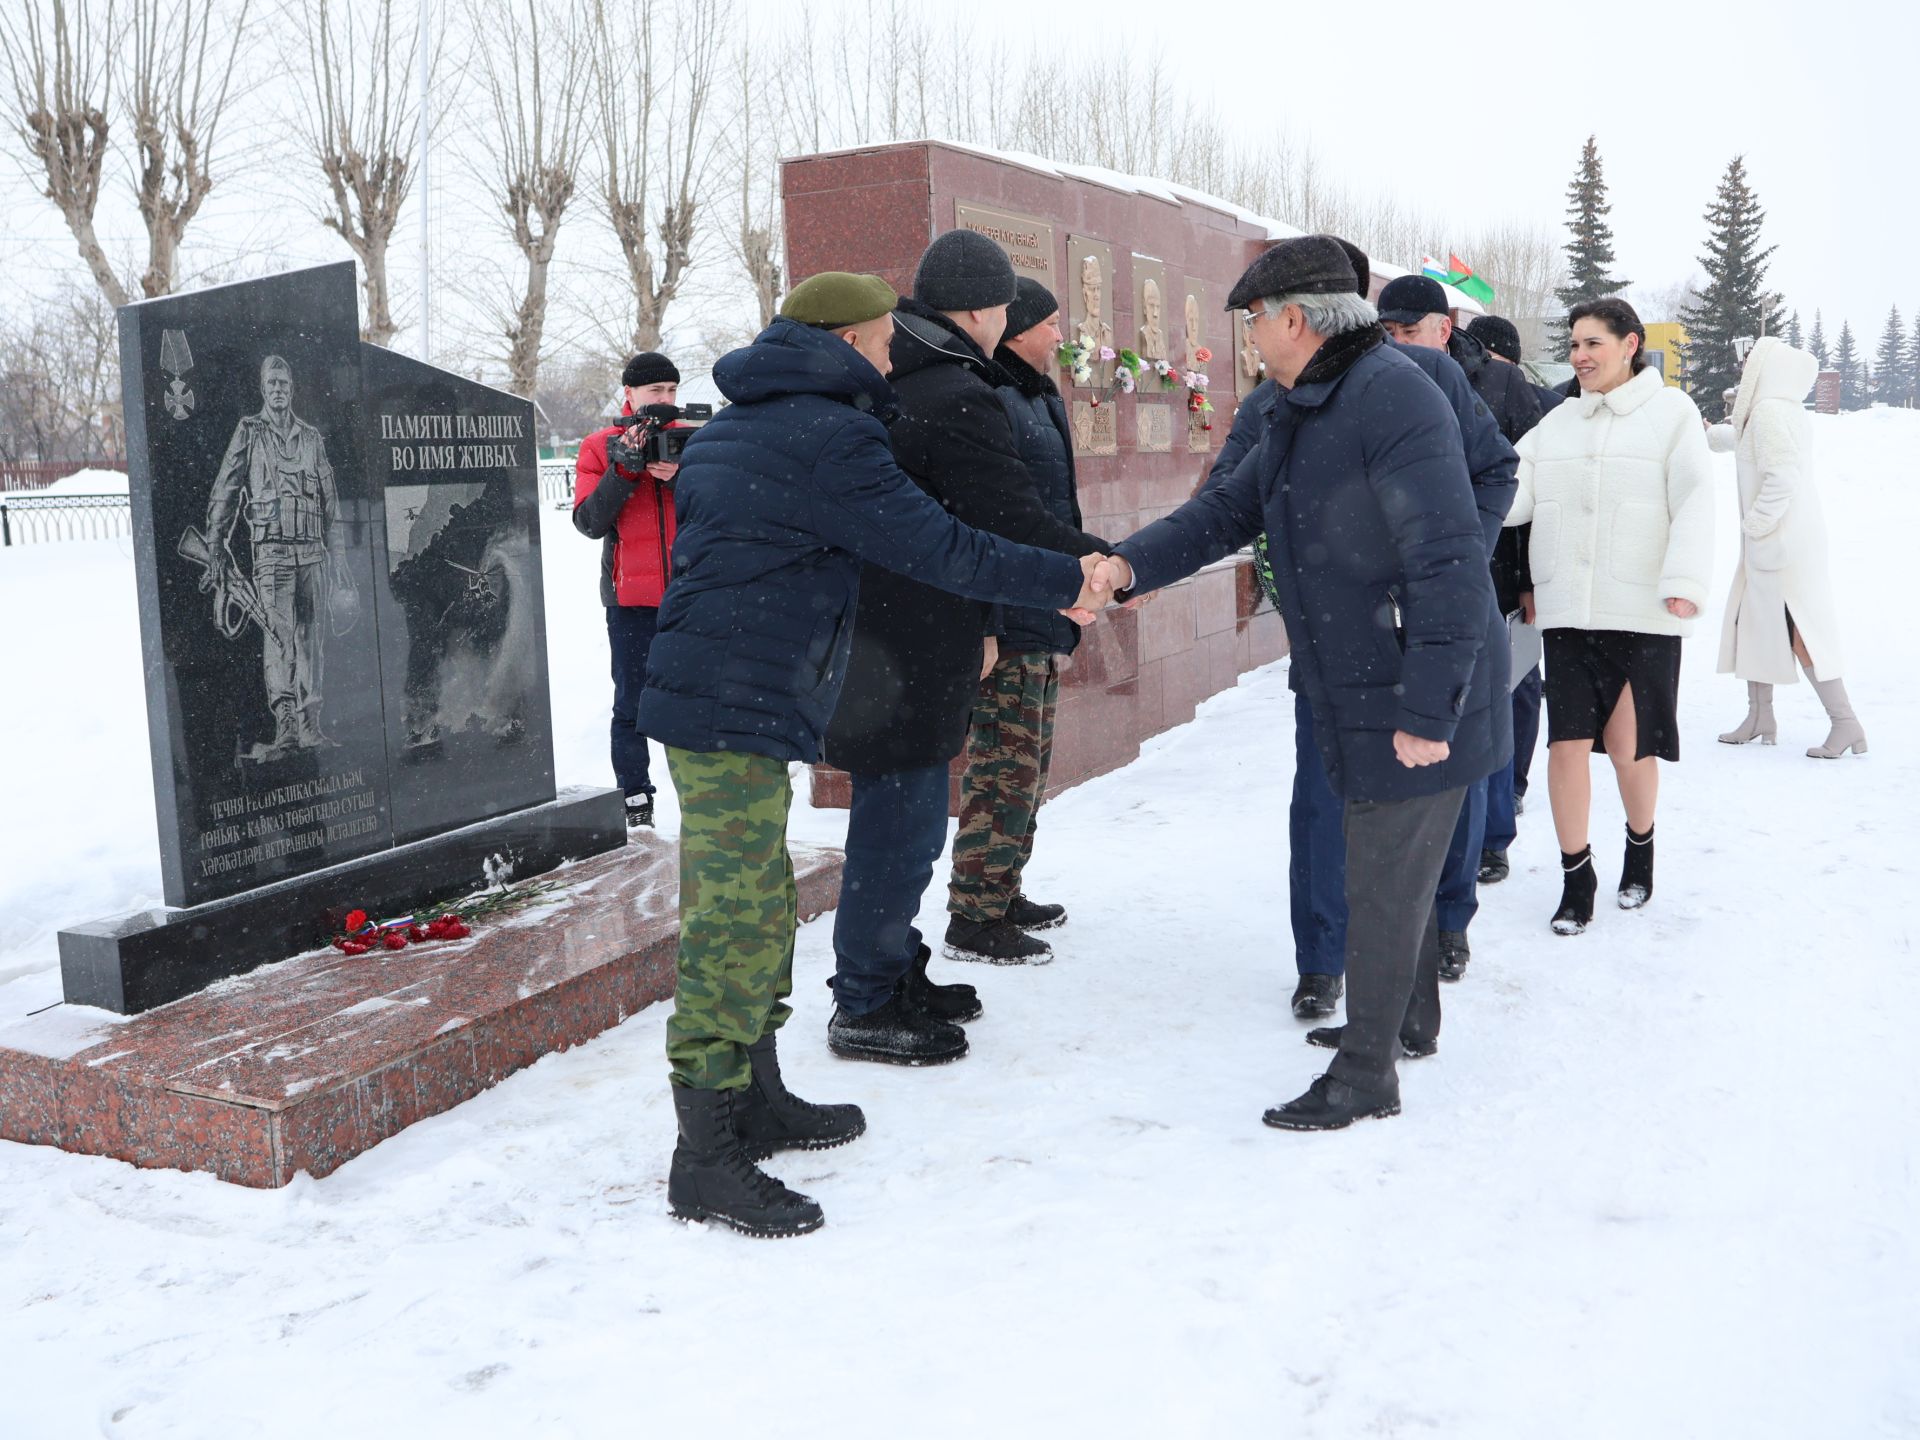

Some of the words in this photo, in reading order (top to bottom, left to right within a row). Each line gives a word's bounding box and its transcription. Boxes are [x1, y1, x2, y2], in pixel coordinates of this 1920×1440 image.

[381, 415, 453, 439] ПАМЯТИ
[456, 415, 523, 438] ПАВШИХ
[392, 446, 415, 470] ВО
[418, 446, 455, 469] ИМЯ
[458, 445, 520, 468] ЖИВЫХ
[210, 797, 244, 820] ЧЕЧНЯ
[247, 814, 285, 838] КАВКАЗ
[285, 799, 340, 828] ТӨБӘГЕНДӘ
[200, 845, 264, 877] ХӘРӘКӘТЛӘРЕ
[264, 829, 324, 859] ВЕТЕРАННАРЫ
